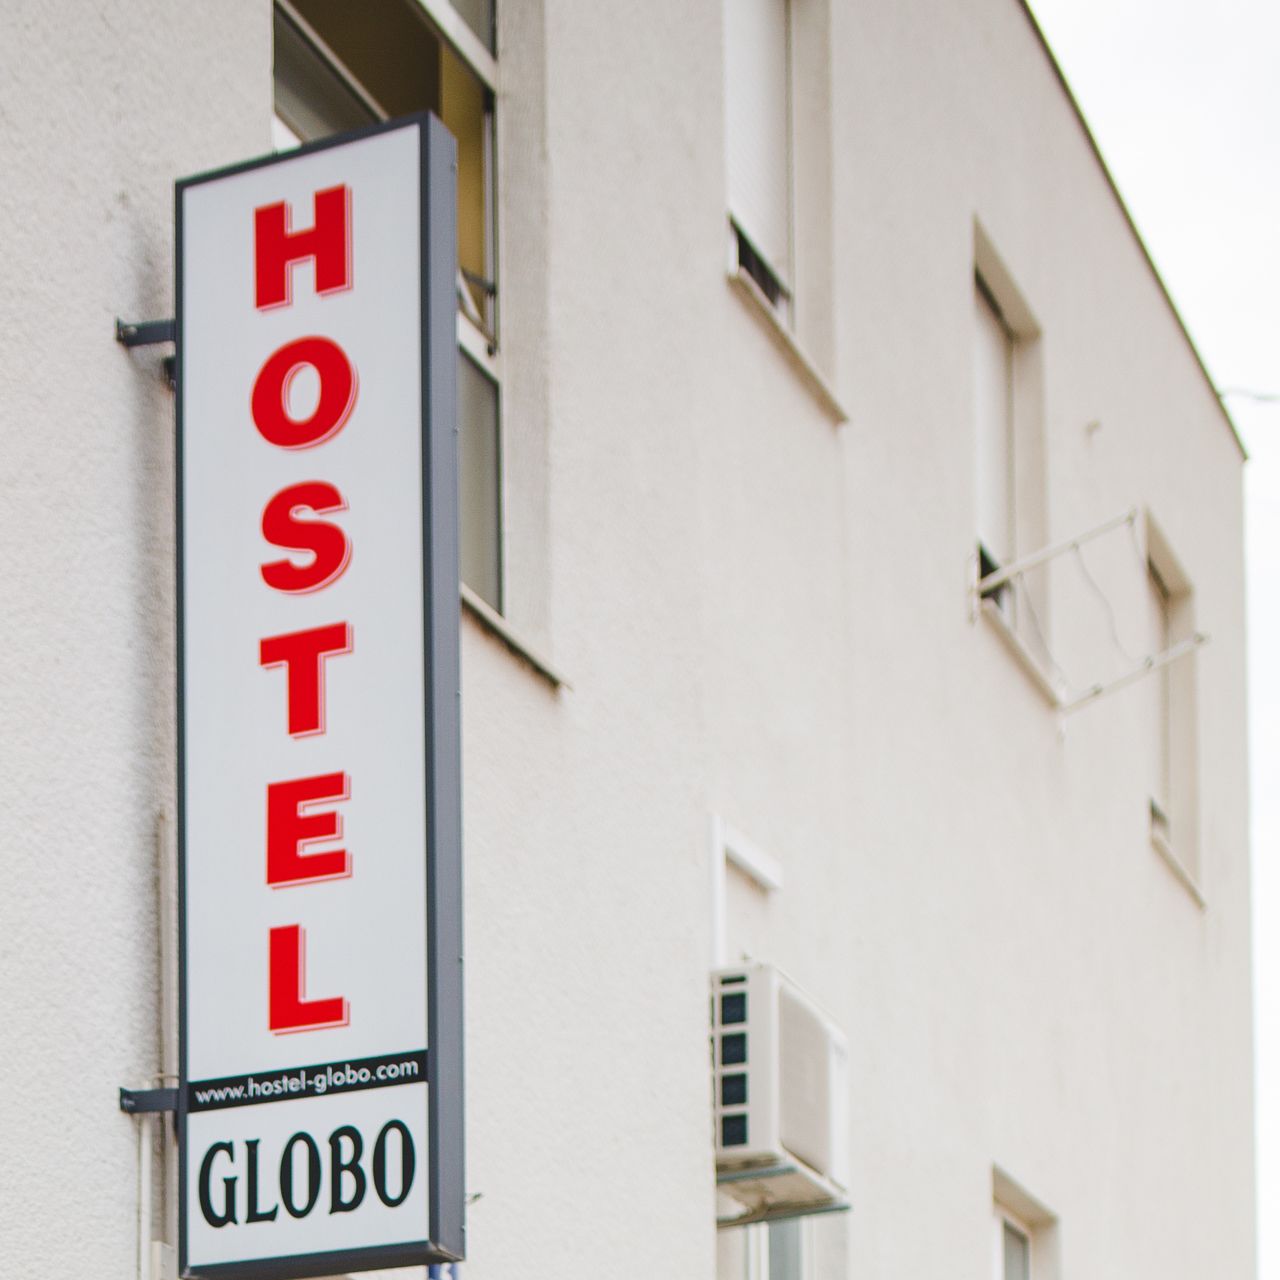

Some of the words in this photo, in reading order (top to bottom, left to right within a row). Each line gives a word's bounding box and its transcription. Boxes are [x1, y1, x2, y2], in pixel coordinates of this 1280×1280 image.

[251, 184, 358, 1035] HOSTEL
[195, 1060, 419, 1104] www.hostel-globo.com
[198, 1118, 416, 1228] GLOBO
